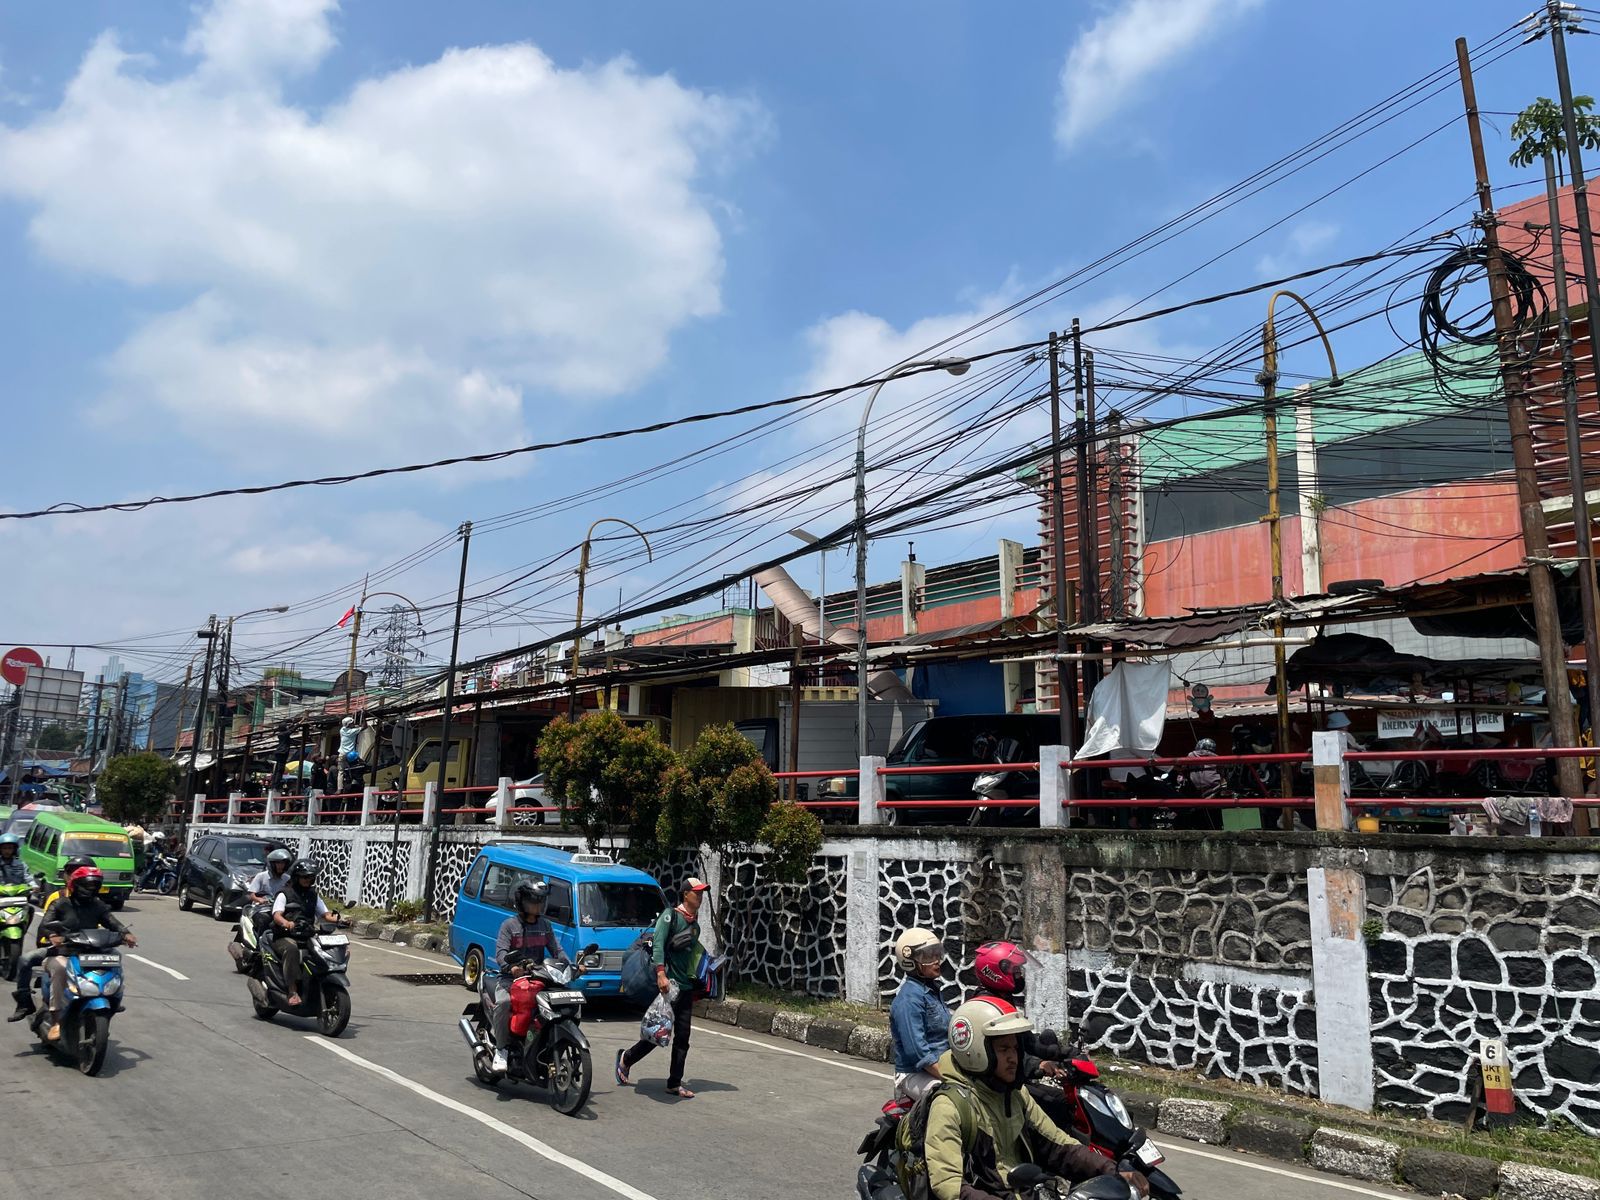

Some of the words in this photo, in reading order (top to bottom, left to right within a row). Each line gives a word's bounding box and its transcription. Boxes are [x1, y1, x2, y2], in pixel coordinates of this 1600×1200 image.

[1466, 714, 1499, 725] GPREK
[1485, 1044, 1495, 1059] 6
[1484, 1065, 1500, 1073] JKT
